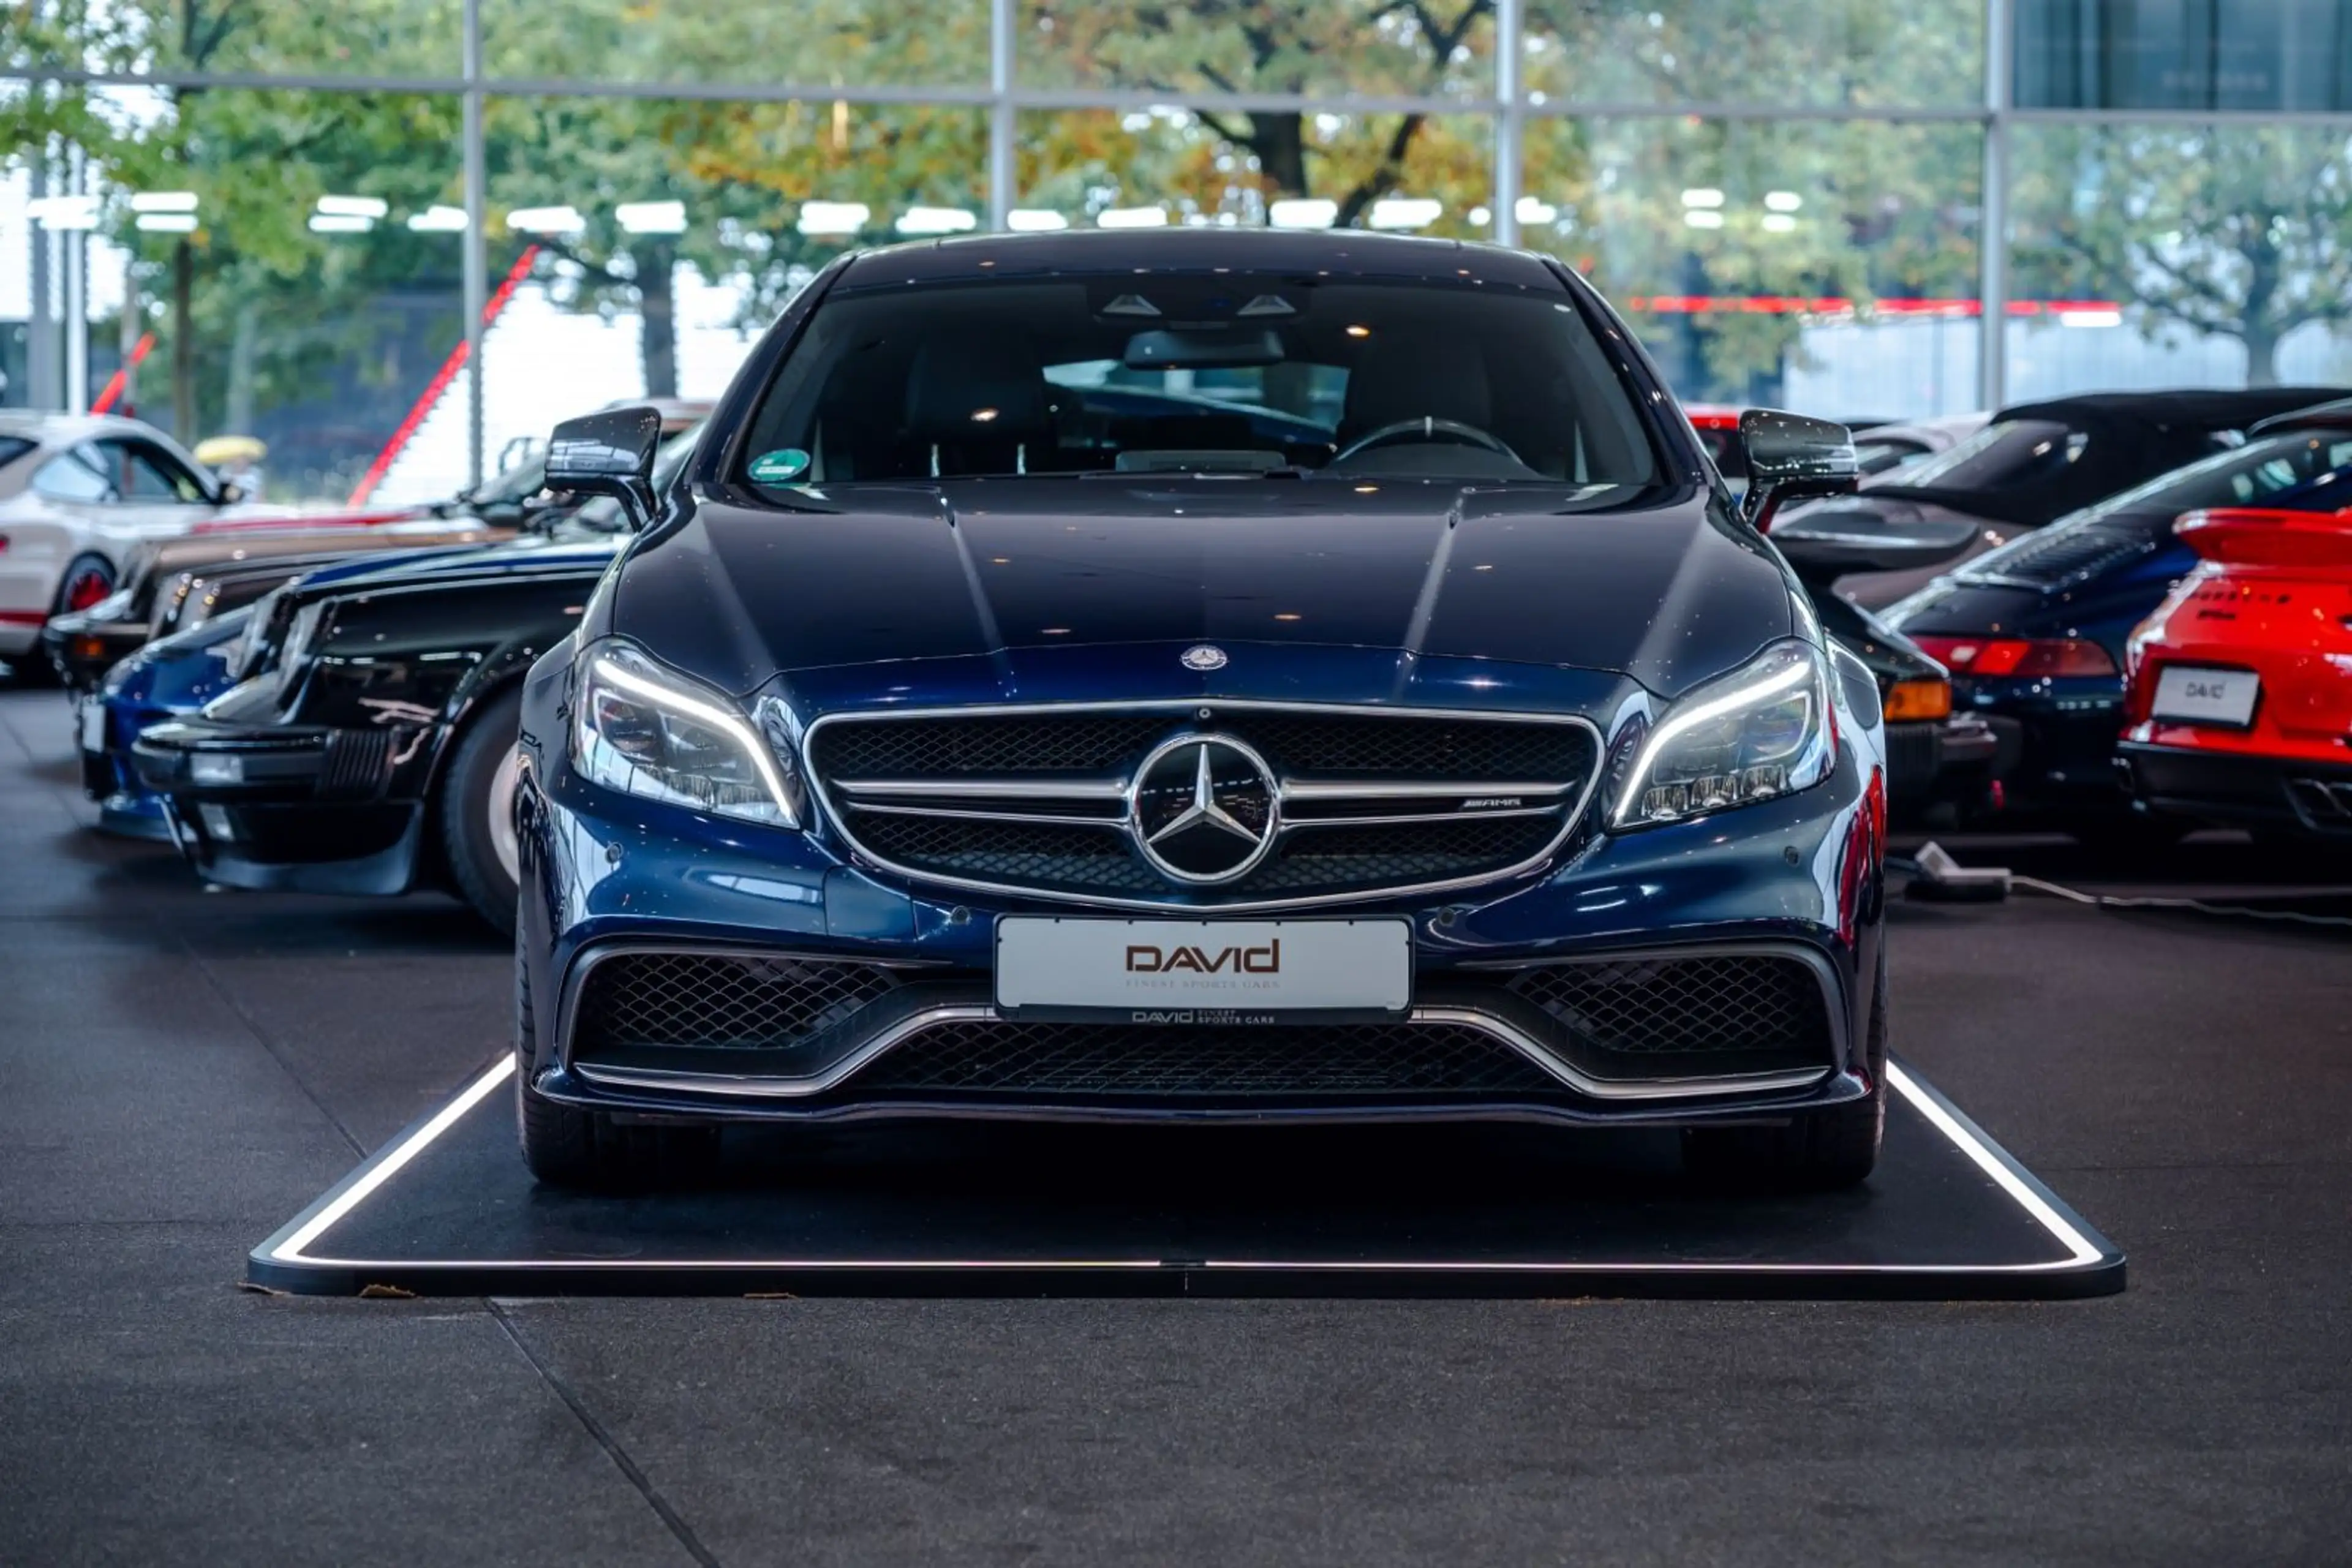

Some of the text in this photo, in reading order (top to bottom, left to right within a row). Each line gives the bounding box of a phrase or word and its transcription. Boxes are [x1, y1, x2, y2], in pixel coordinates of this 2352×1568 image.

[1126, 979, 1281, 989] FINEST SPORTS CARS
